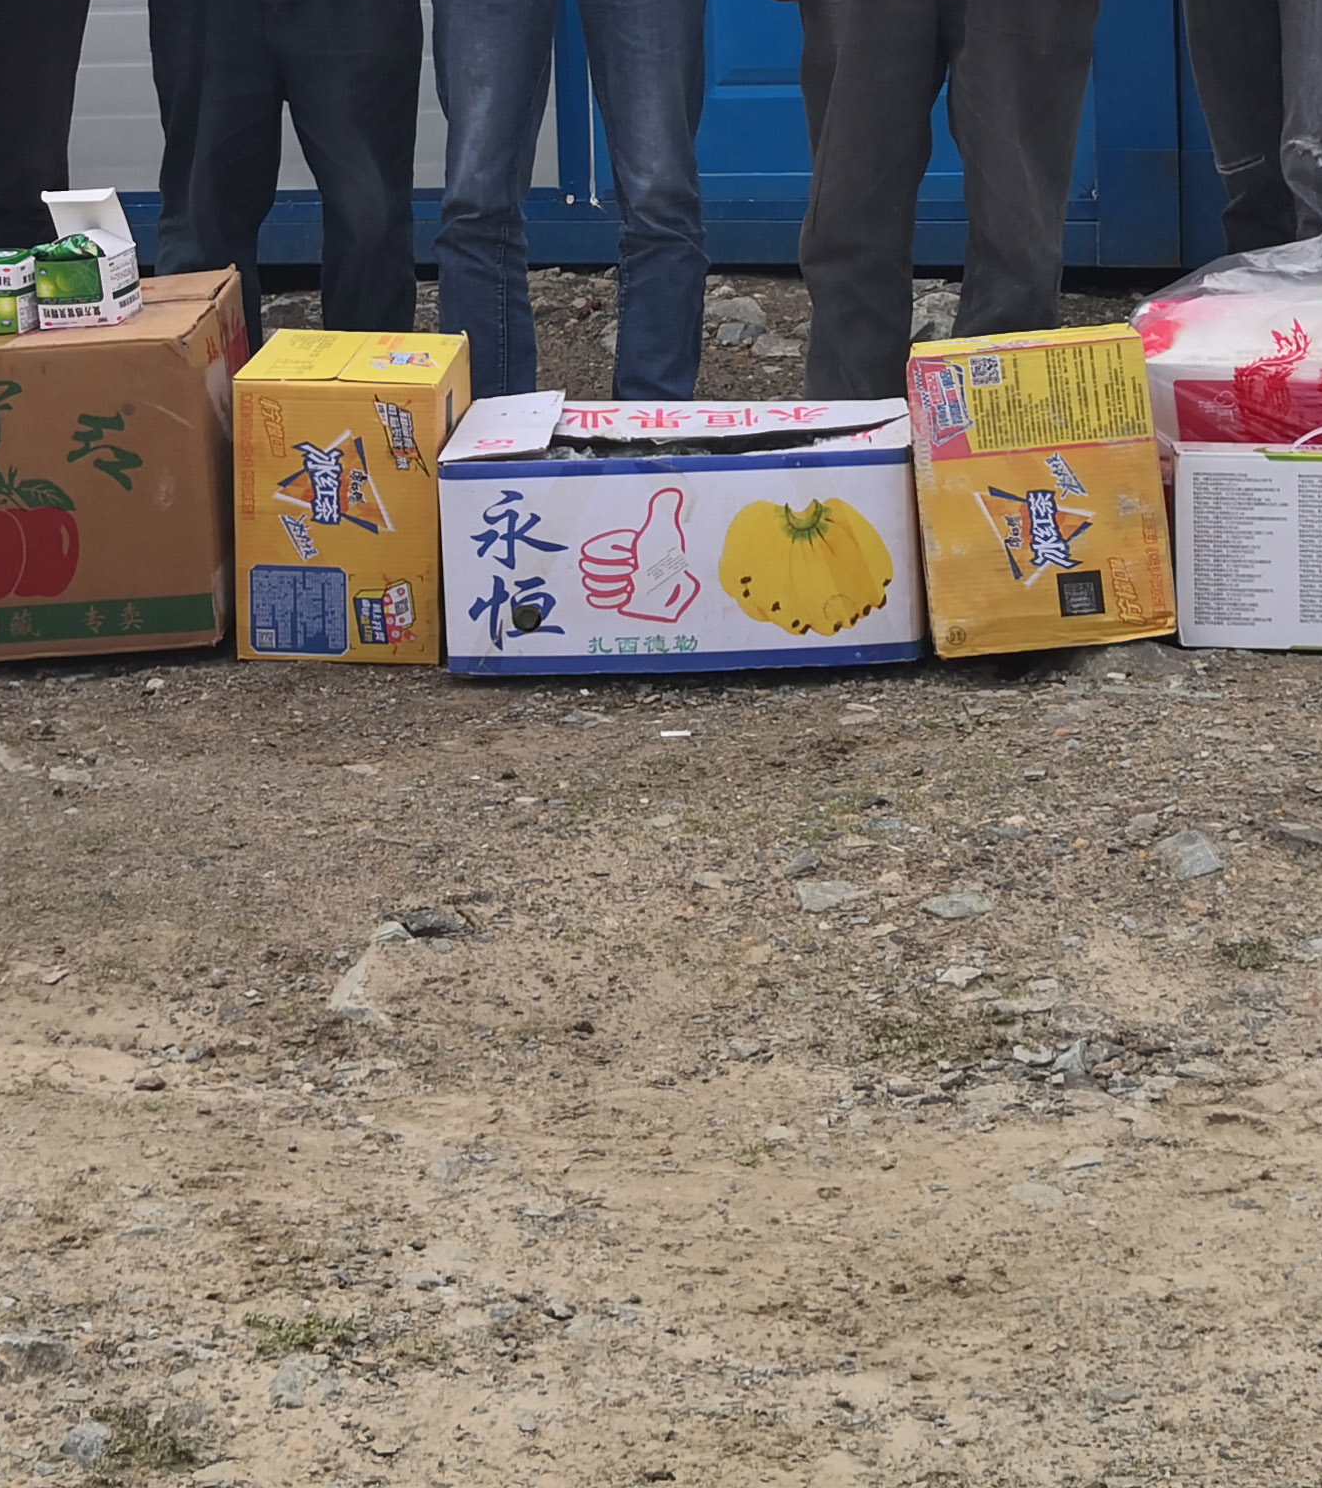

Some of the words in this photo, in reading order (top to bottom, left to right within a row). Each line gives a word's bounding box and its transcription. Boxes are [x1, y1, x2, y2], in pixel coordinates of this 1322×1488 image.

[292, 442, 344, 525] 冰红茶
[1028, 491, 1081, 569] 冰红茶
[468, 490, 570, 651] 永恒
[84, 602, 144, 634] 专卖
[588, 634, 699, 655] 扎西德勒
